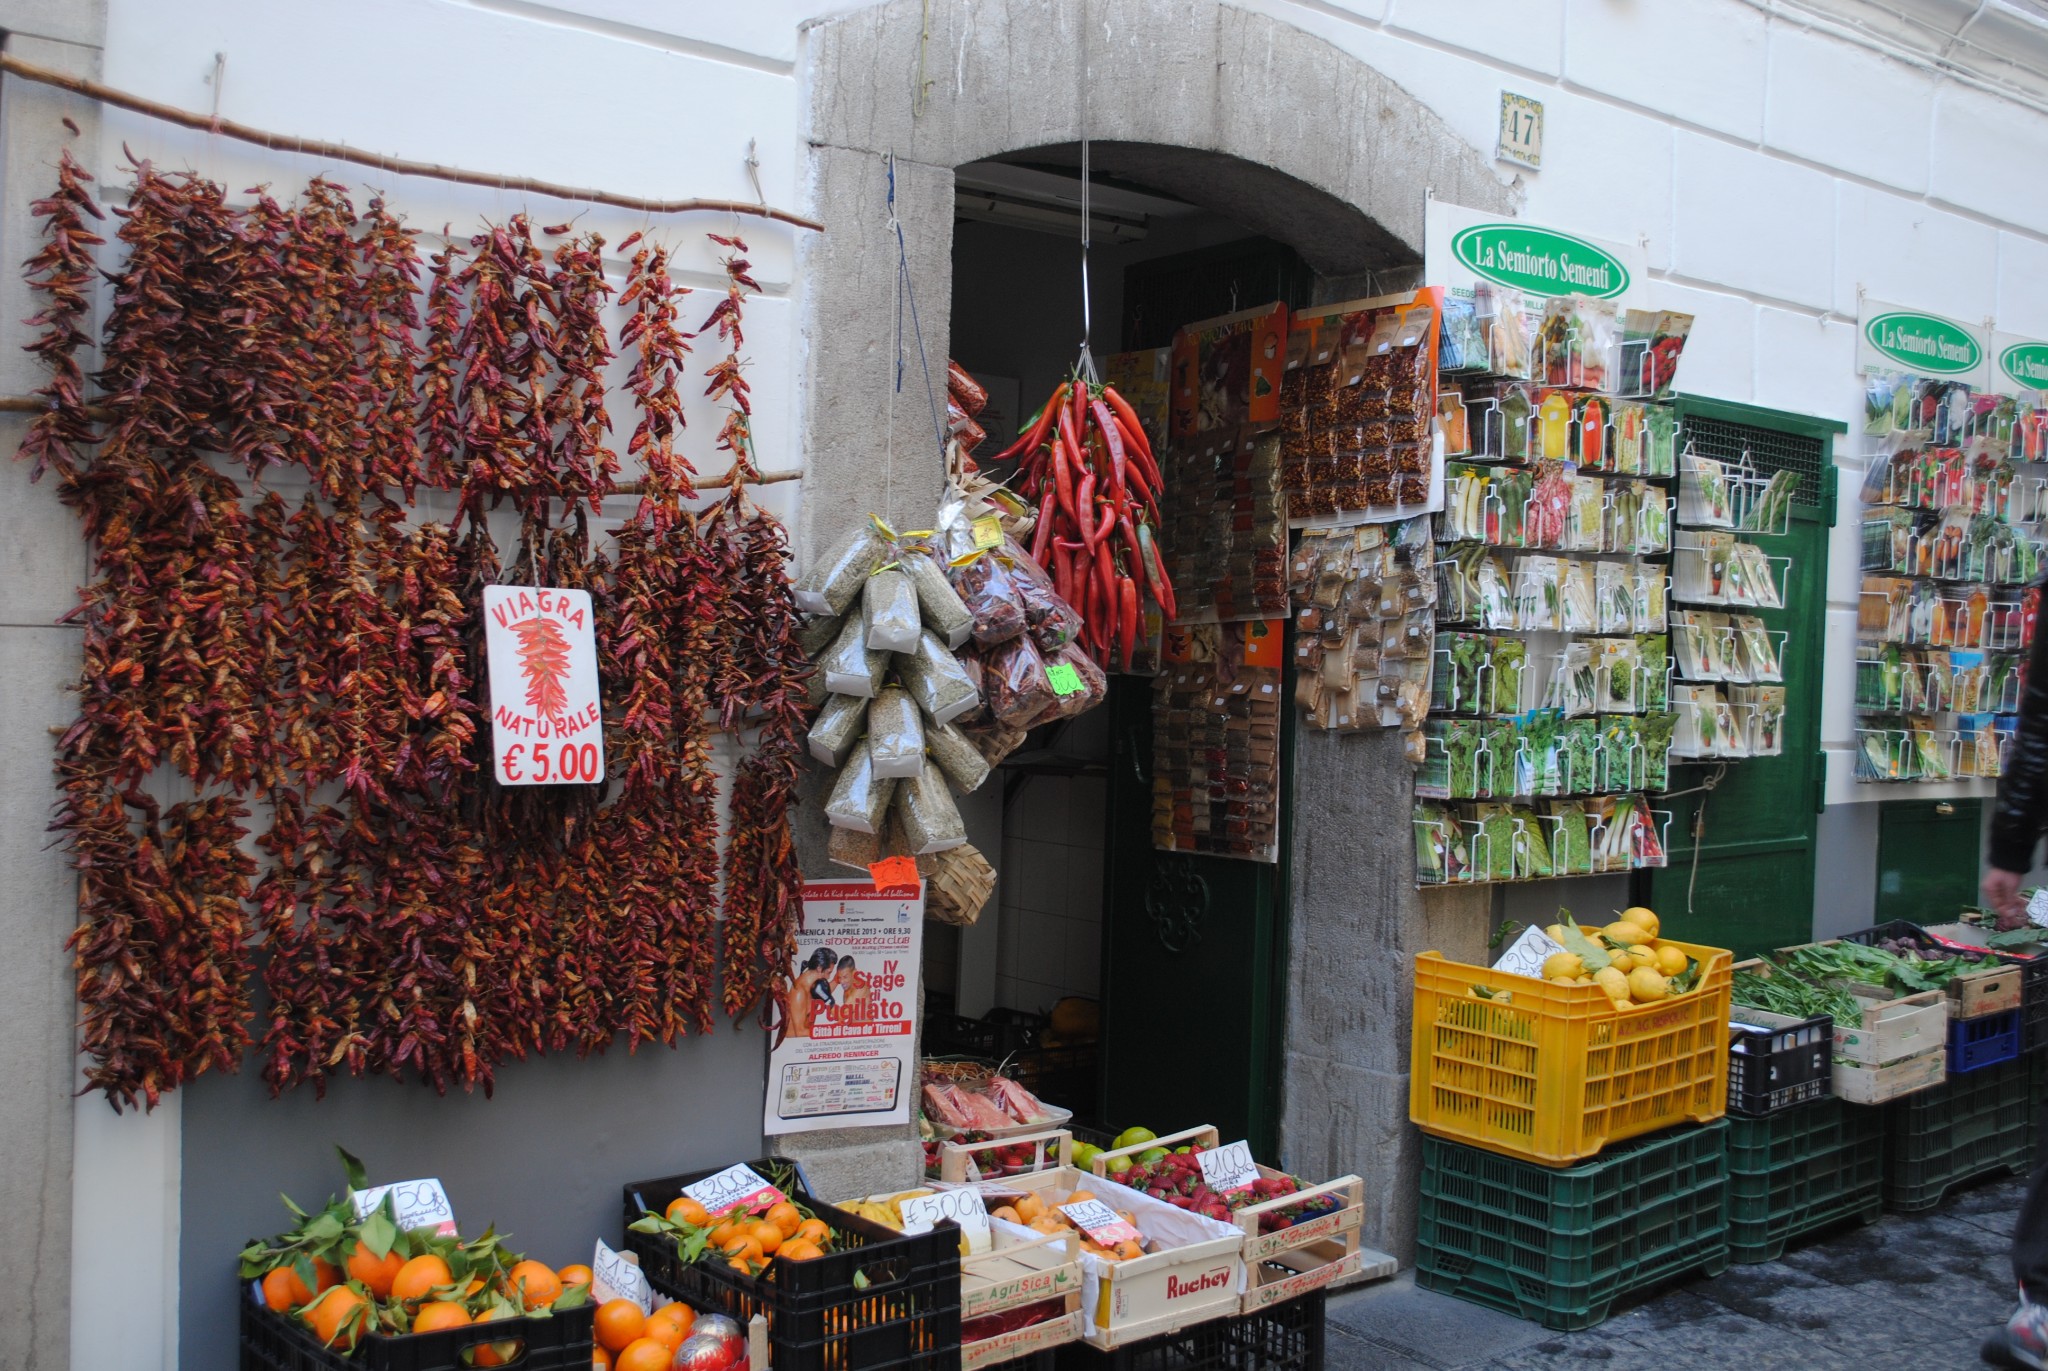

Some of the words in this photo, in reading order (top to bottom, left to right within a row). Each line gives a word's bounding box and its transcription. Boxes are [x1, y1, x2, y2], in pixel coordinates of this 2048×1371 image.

[1508, 110, 1534, 146] 47
[1475, 236, 1494, 267] La
[1498, 240, 1558, 280] Semiorto
[1560, 253, 1610, 290] Sementi
[1881, 323, 1895, 347] La
[1896, 326, 1936, 357] Semiorto
[1938, 334, 1970, 364] Sementi
[2013, 352, 2024, 376] La
[491, 590, 585, 631] VIAGRA
[495, 702, 600, 739] NATURALE
[797, 937, 824, 946] ALESTRA
[827, 928, 835, 936] 21
[837, 928, 860, 936] APRILE
[862, 927, 877, 935] 2013
[883, 927, 897, 935] ORE
[883, 960, 899, 974] IV
[852, 971, 905, 992] Stage
[869, 989, 881, 1001] di
[808, 998, 903, 1026] Pugilato
[813, 1026, 832, 1037] Città
[833, 1025, 842, 1036] di
[842, 1025, 862, 1035] Cava
[875, 1023, 902, 1034] Tirreni
[808, 1052, 841, 1060] ALFREDO
[1167, 1268, 1231, 1299] Ruchey
